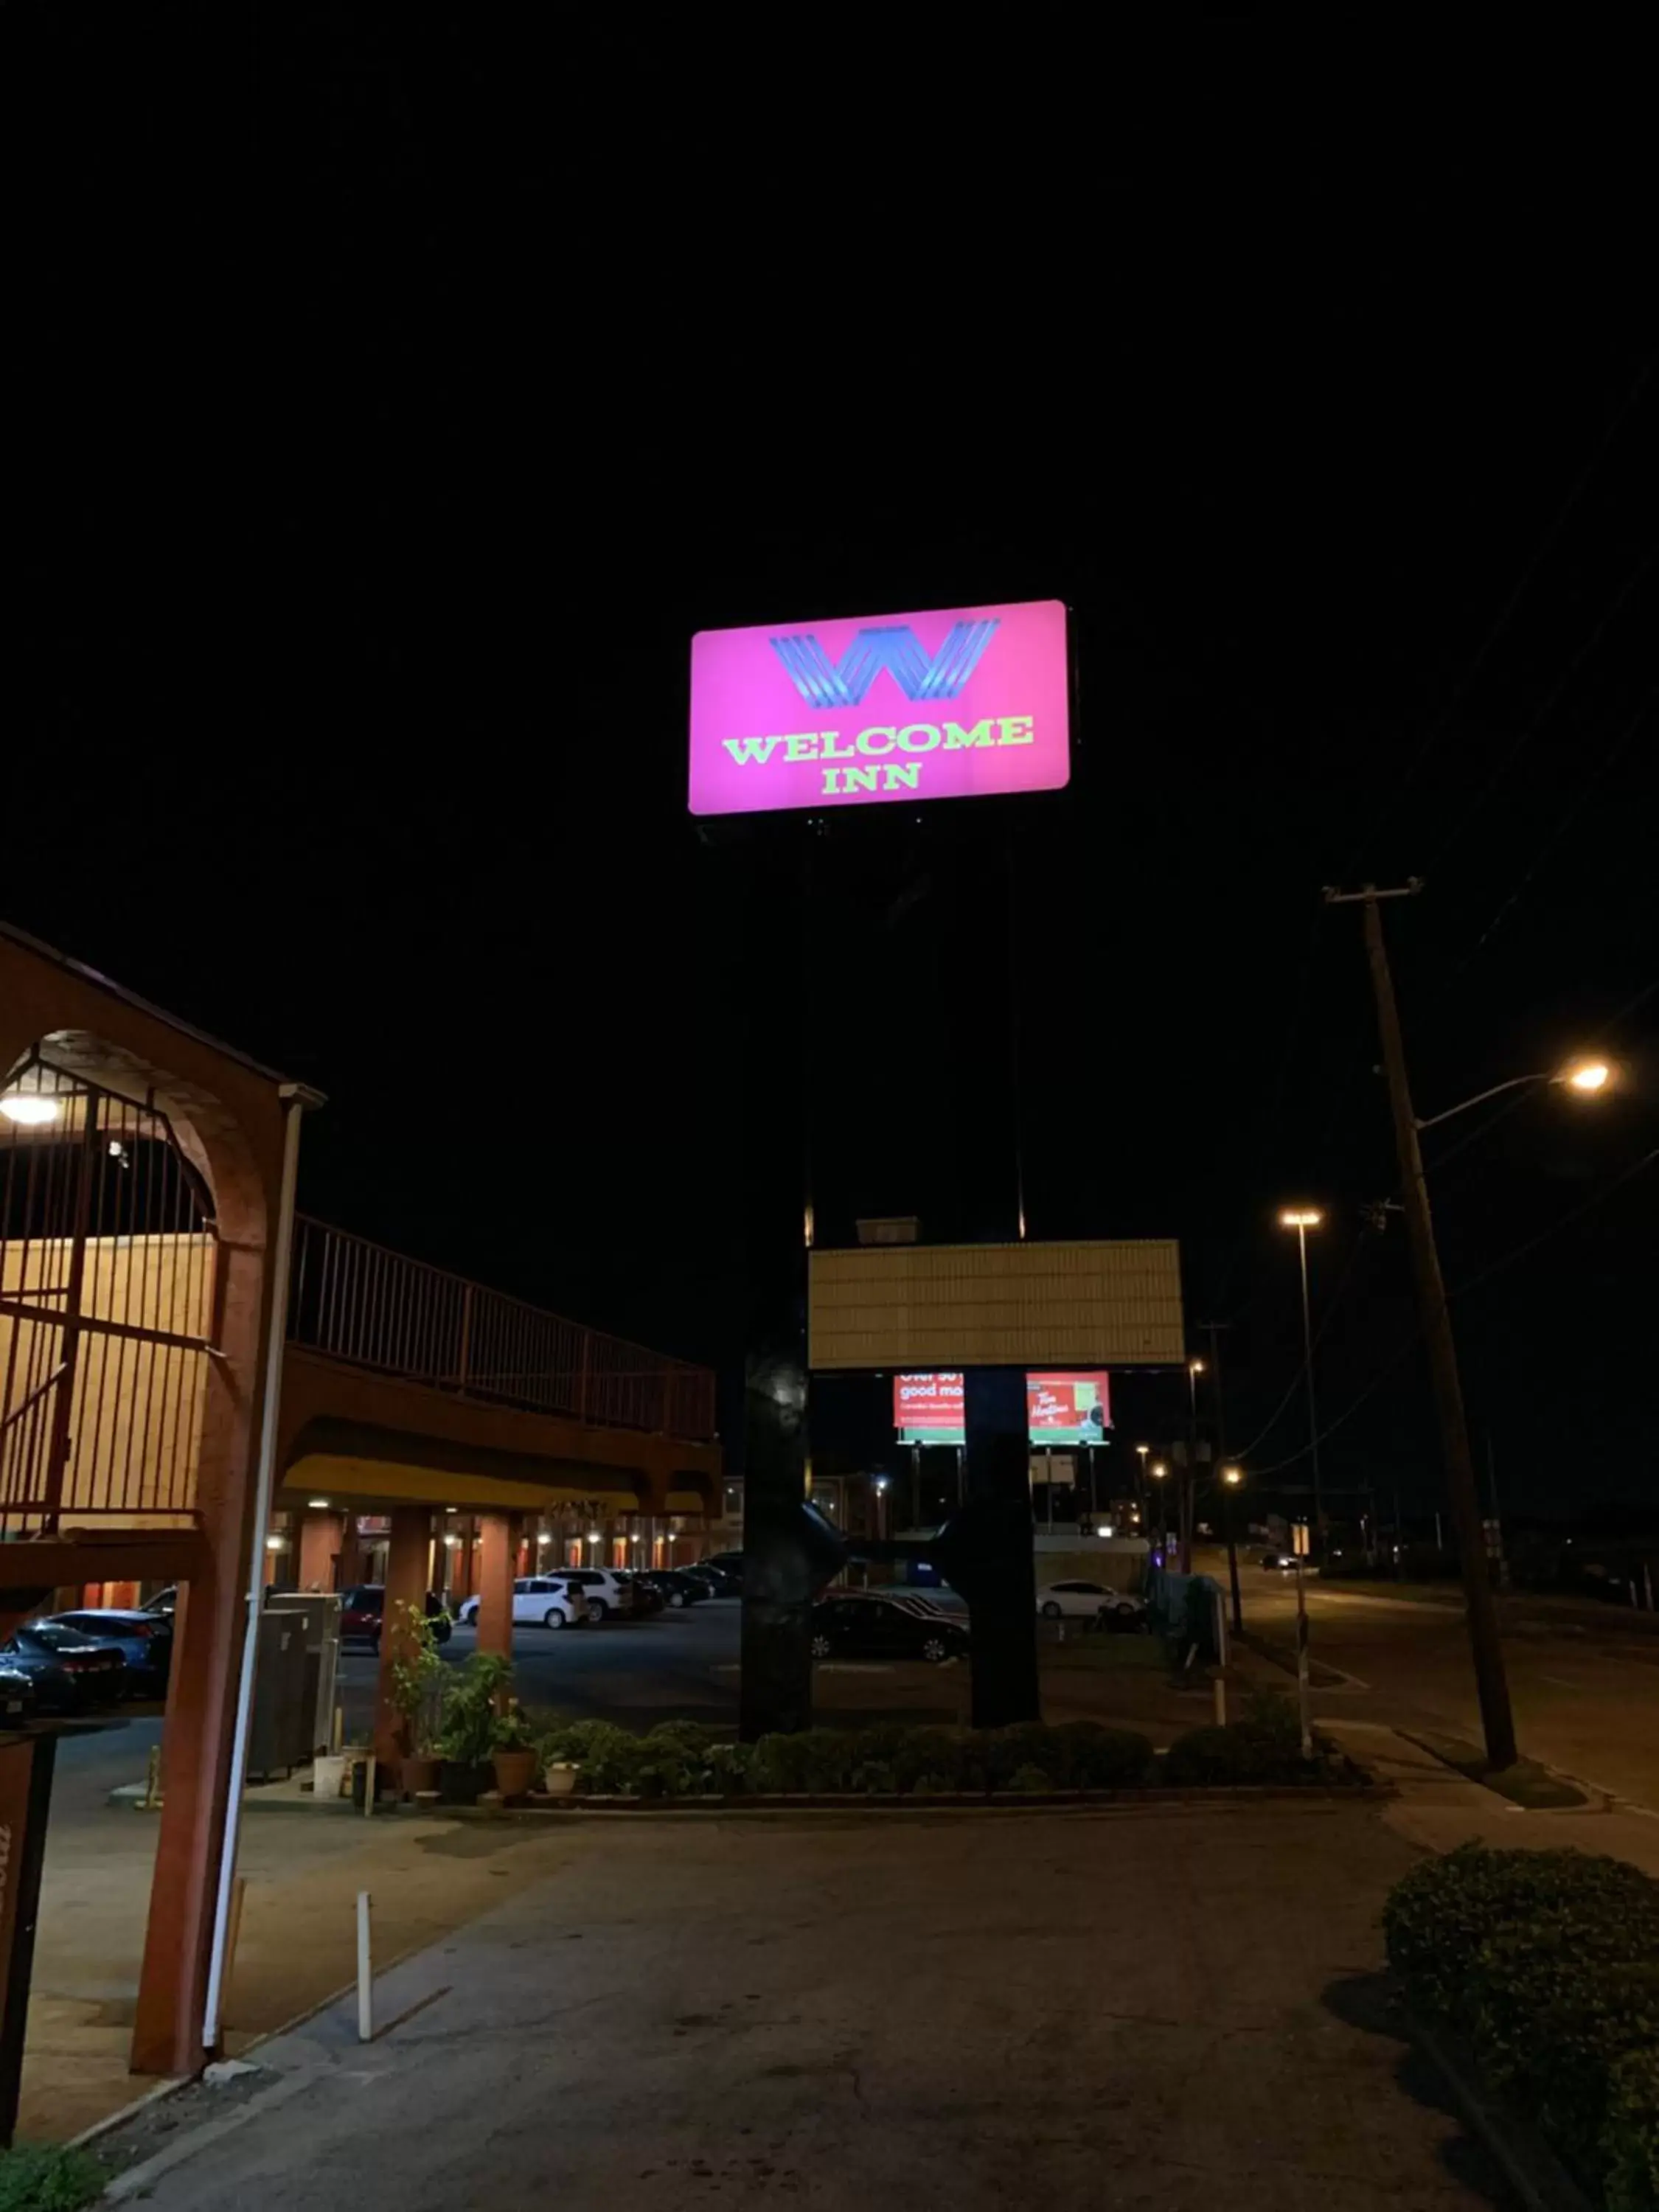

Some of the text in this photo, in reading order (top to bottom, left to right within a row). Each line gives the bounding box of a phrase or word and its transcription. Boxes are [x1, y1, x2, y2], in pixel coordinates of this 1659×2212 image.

[723, 715, 1034, 765] WELCOME
[821, 762, 922, 795] INN
[900, 1383, 937, 1400] good
